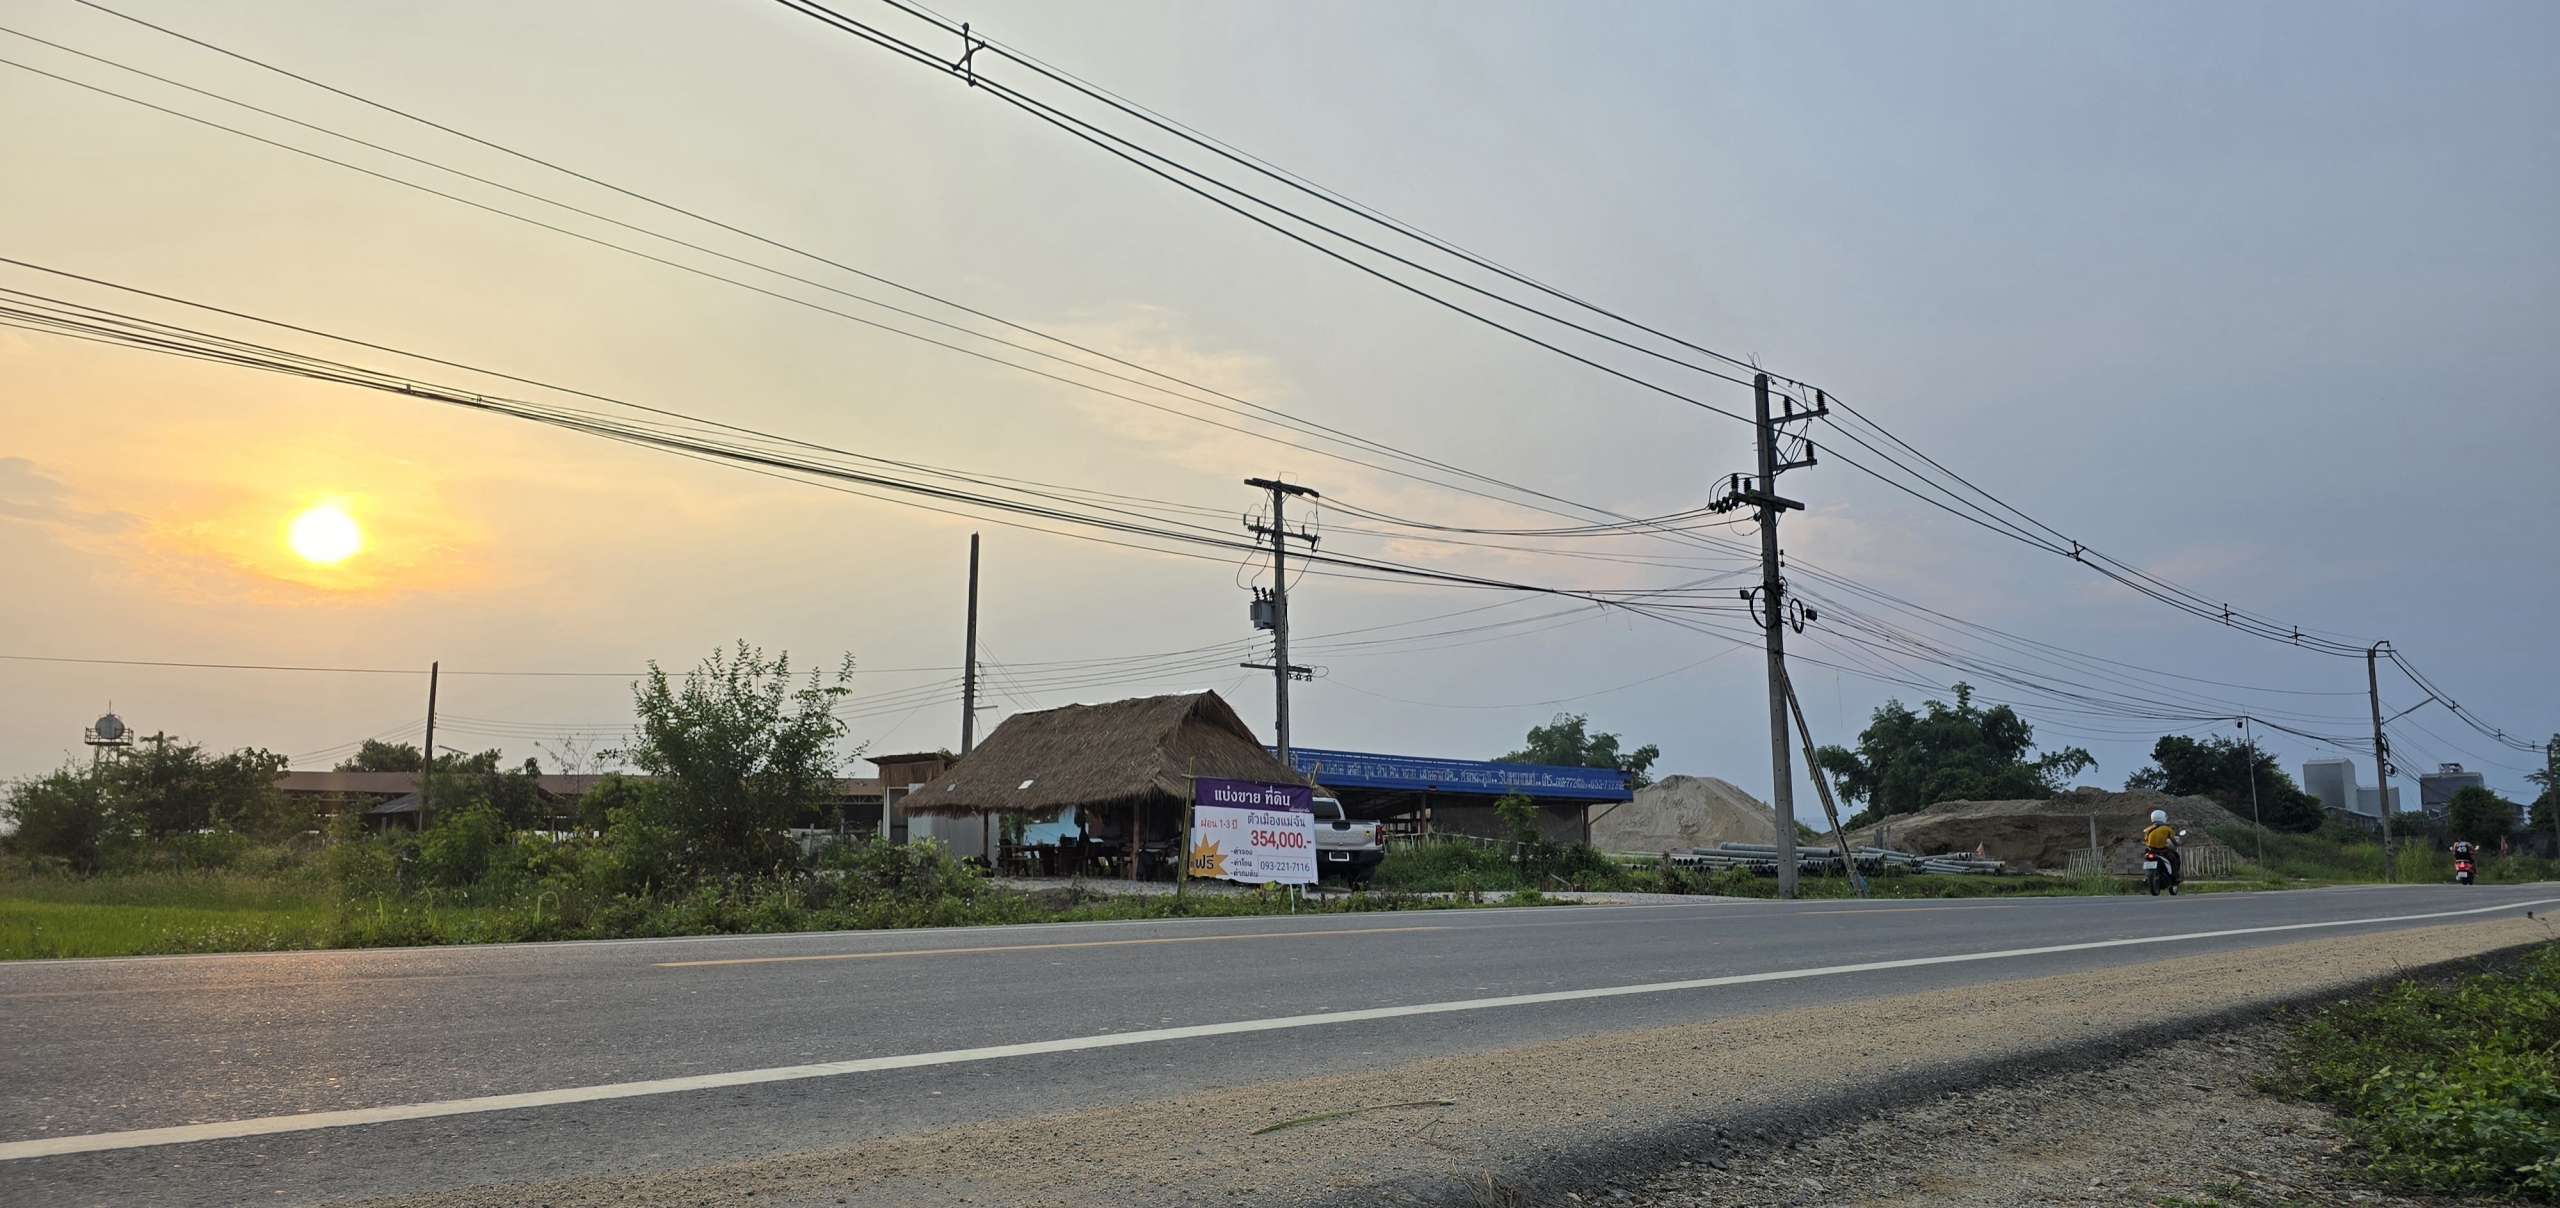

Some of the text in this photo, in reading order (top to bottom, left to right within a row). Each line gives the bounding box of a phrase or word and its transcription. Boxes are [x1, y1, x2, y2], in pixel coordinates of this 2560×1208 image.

[1214, 785, 1290, 806] แบ่งขาย ที่ดิน
[1219, 819, 1231, 829] 1-3
[1232, 818, 1238, 830] ปี
[1247, 812, 1306, 828] ตัวเมืองแม่จัน
[1251, 830, 1312, 850] 354,000.-
[1319, 832, 1362, 842] TOYOTA
[1195, 854, 1214, 870] ฟรี
[1260, 860, 1310, 873] 093-221-7116
